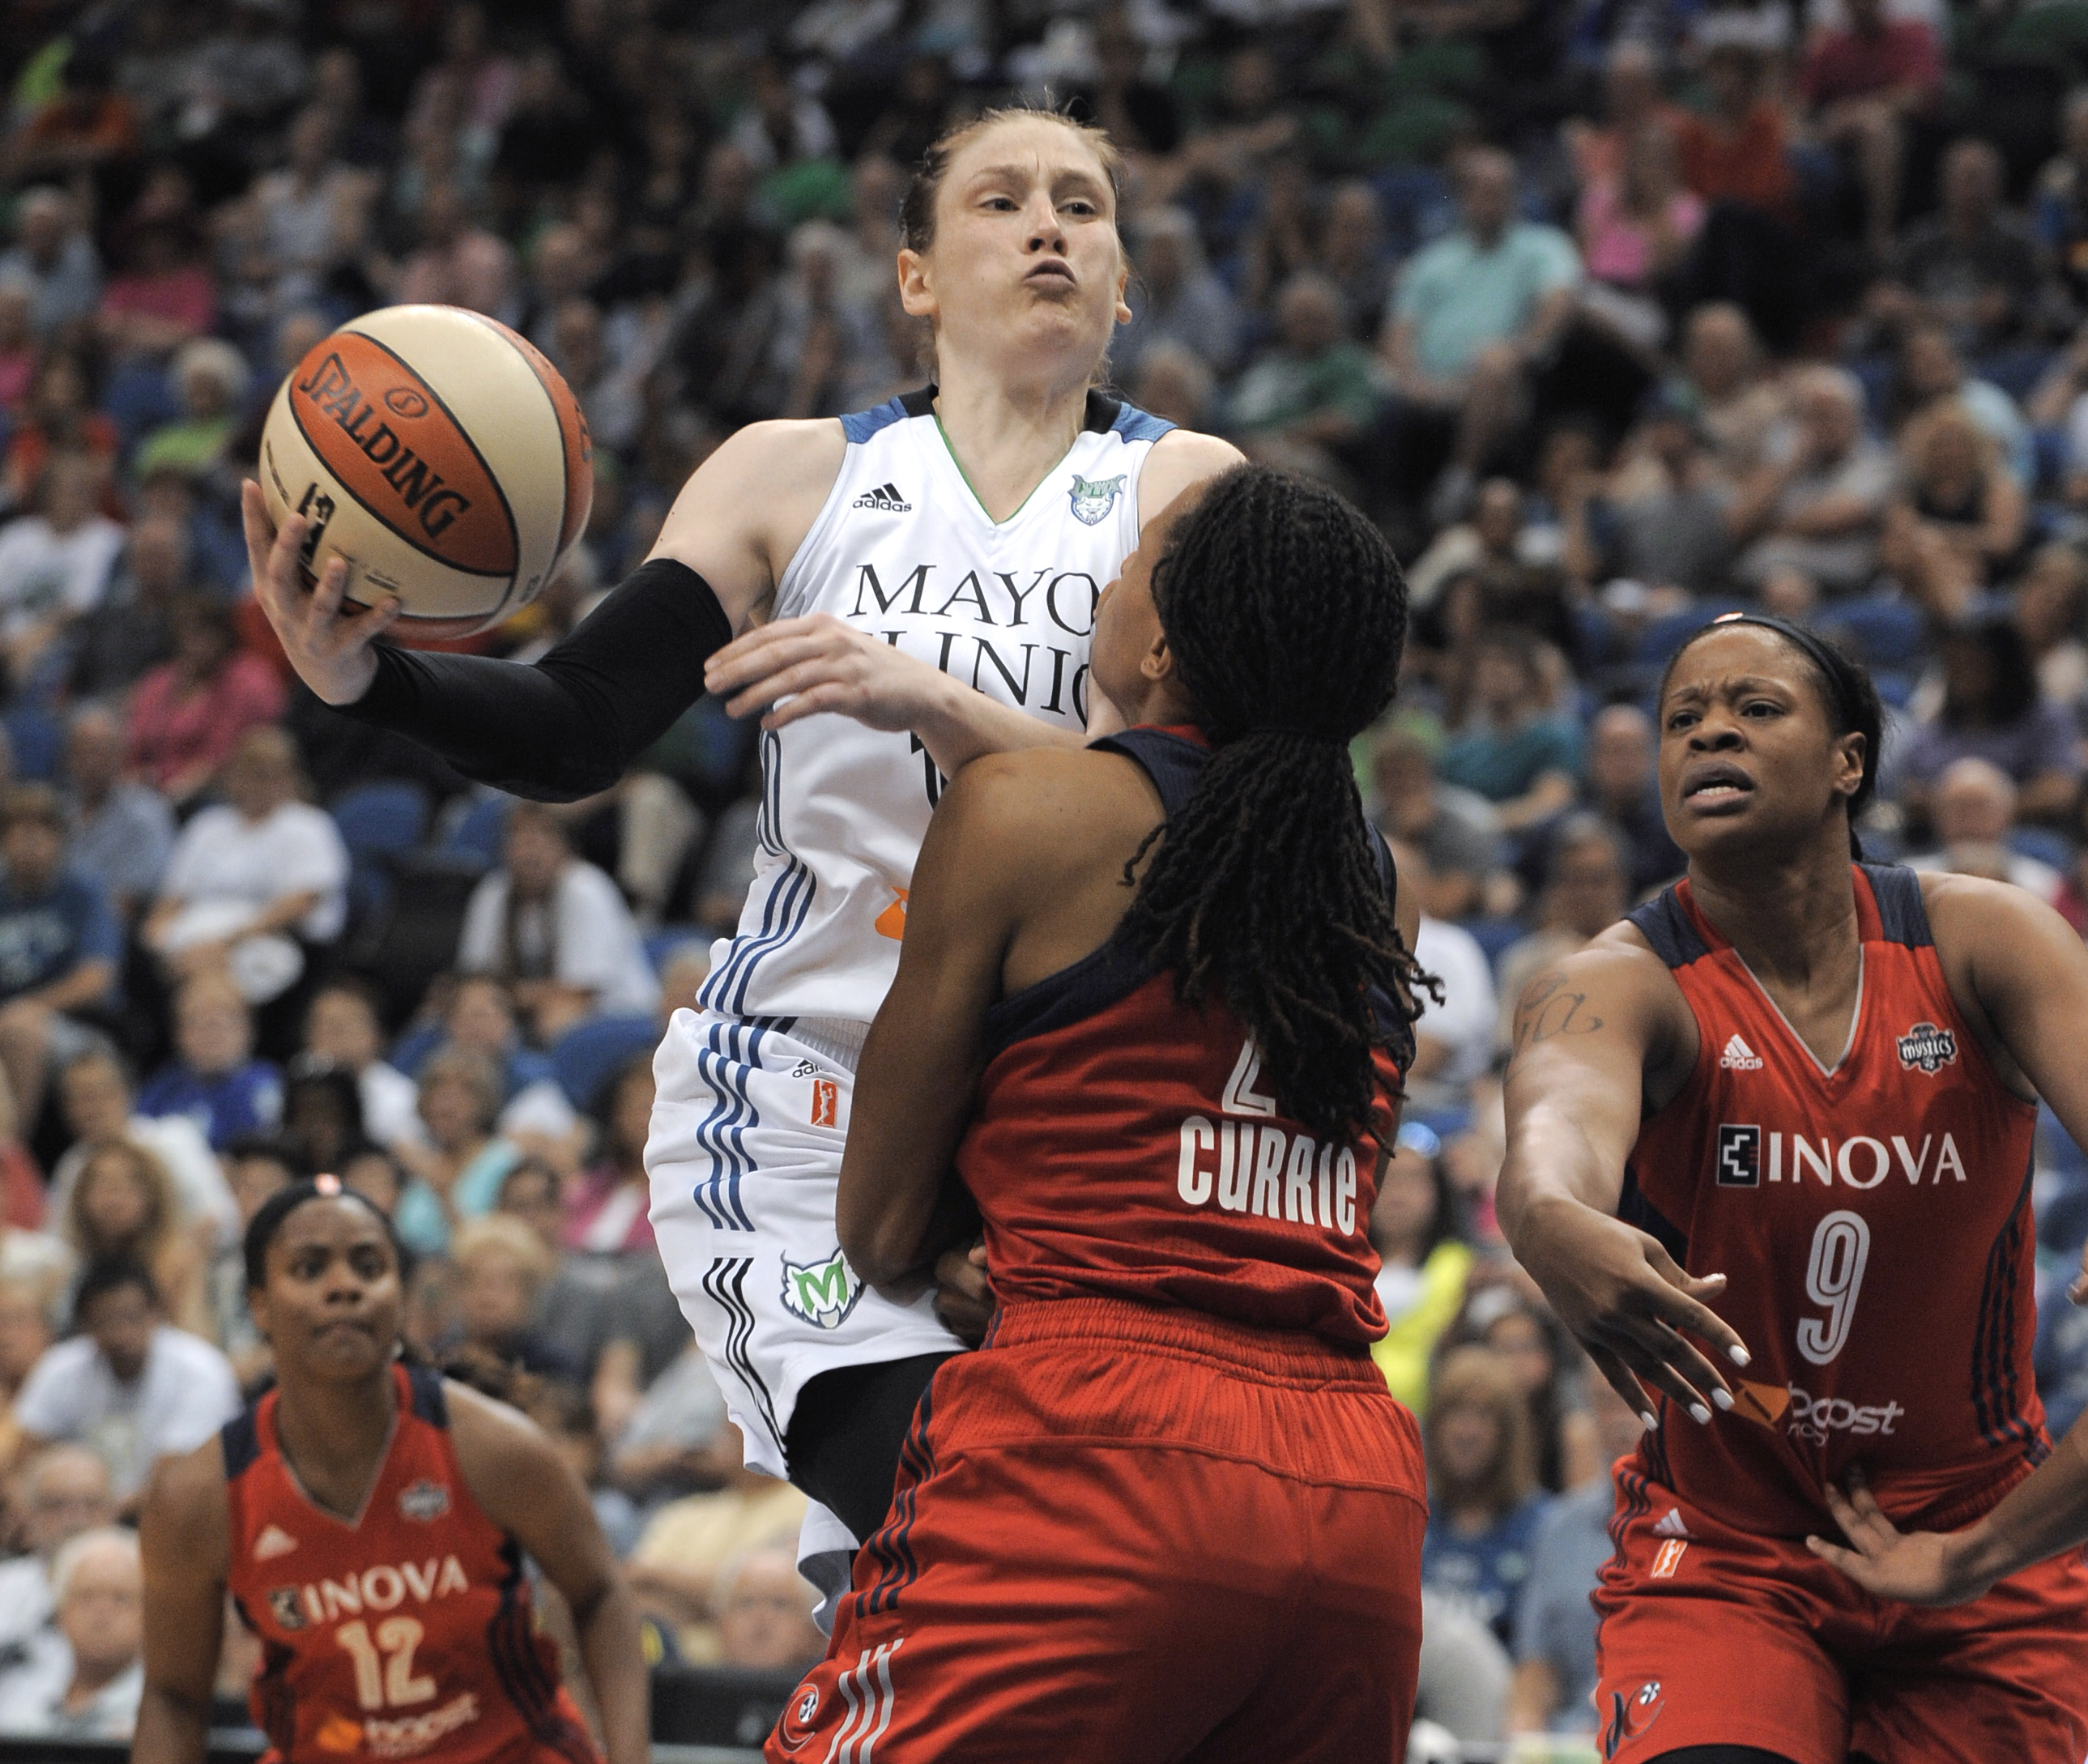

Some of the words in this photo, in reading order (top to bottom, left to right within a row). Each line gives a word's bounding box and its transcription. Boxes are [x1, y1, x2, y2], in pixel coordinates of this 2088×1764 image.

[298, 352, 470, 539] SPALDING
[853, 497, 913, 513] adidas
[847, 563, 1100, 637] MAYO
[1719, 1055, 1763, 1070] adidas
[1768, 1131, 1967, 1189] INOVA
[1796, 1209, 1871, 1366] 9
[304, 1553, 470, 1624] INOVA
[335, 1615, 438, 1711] 12
